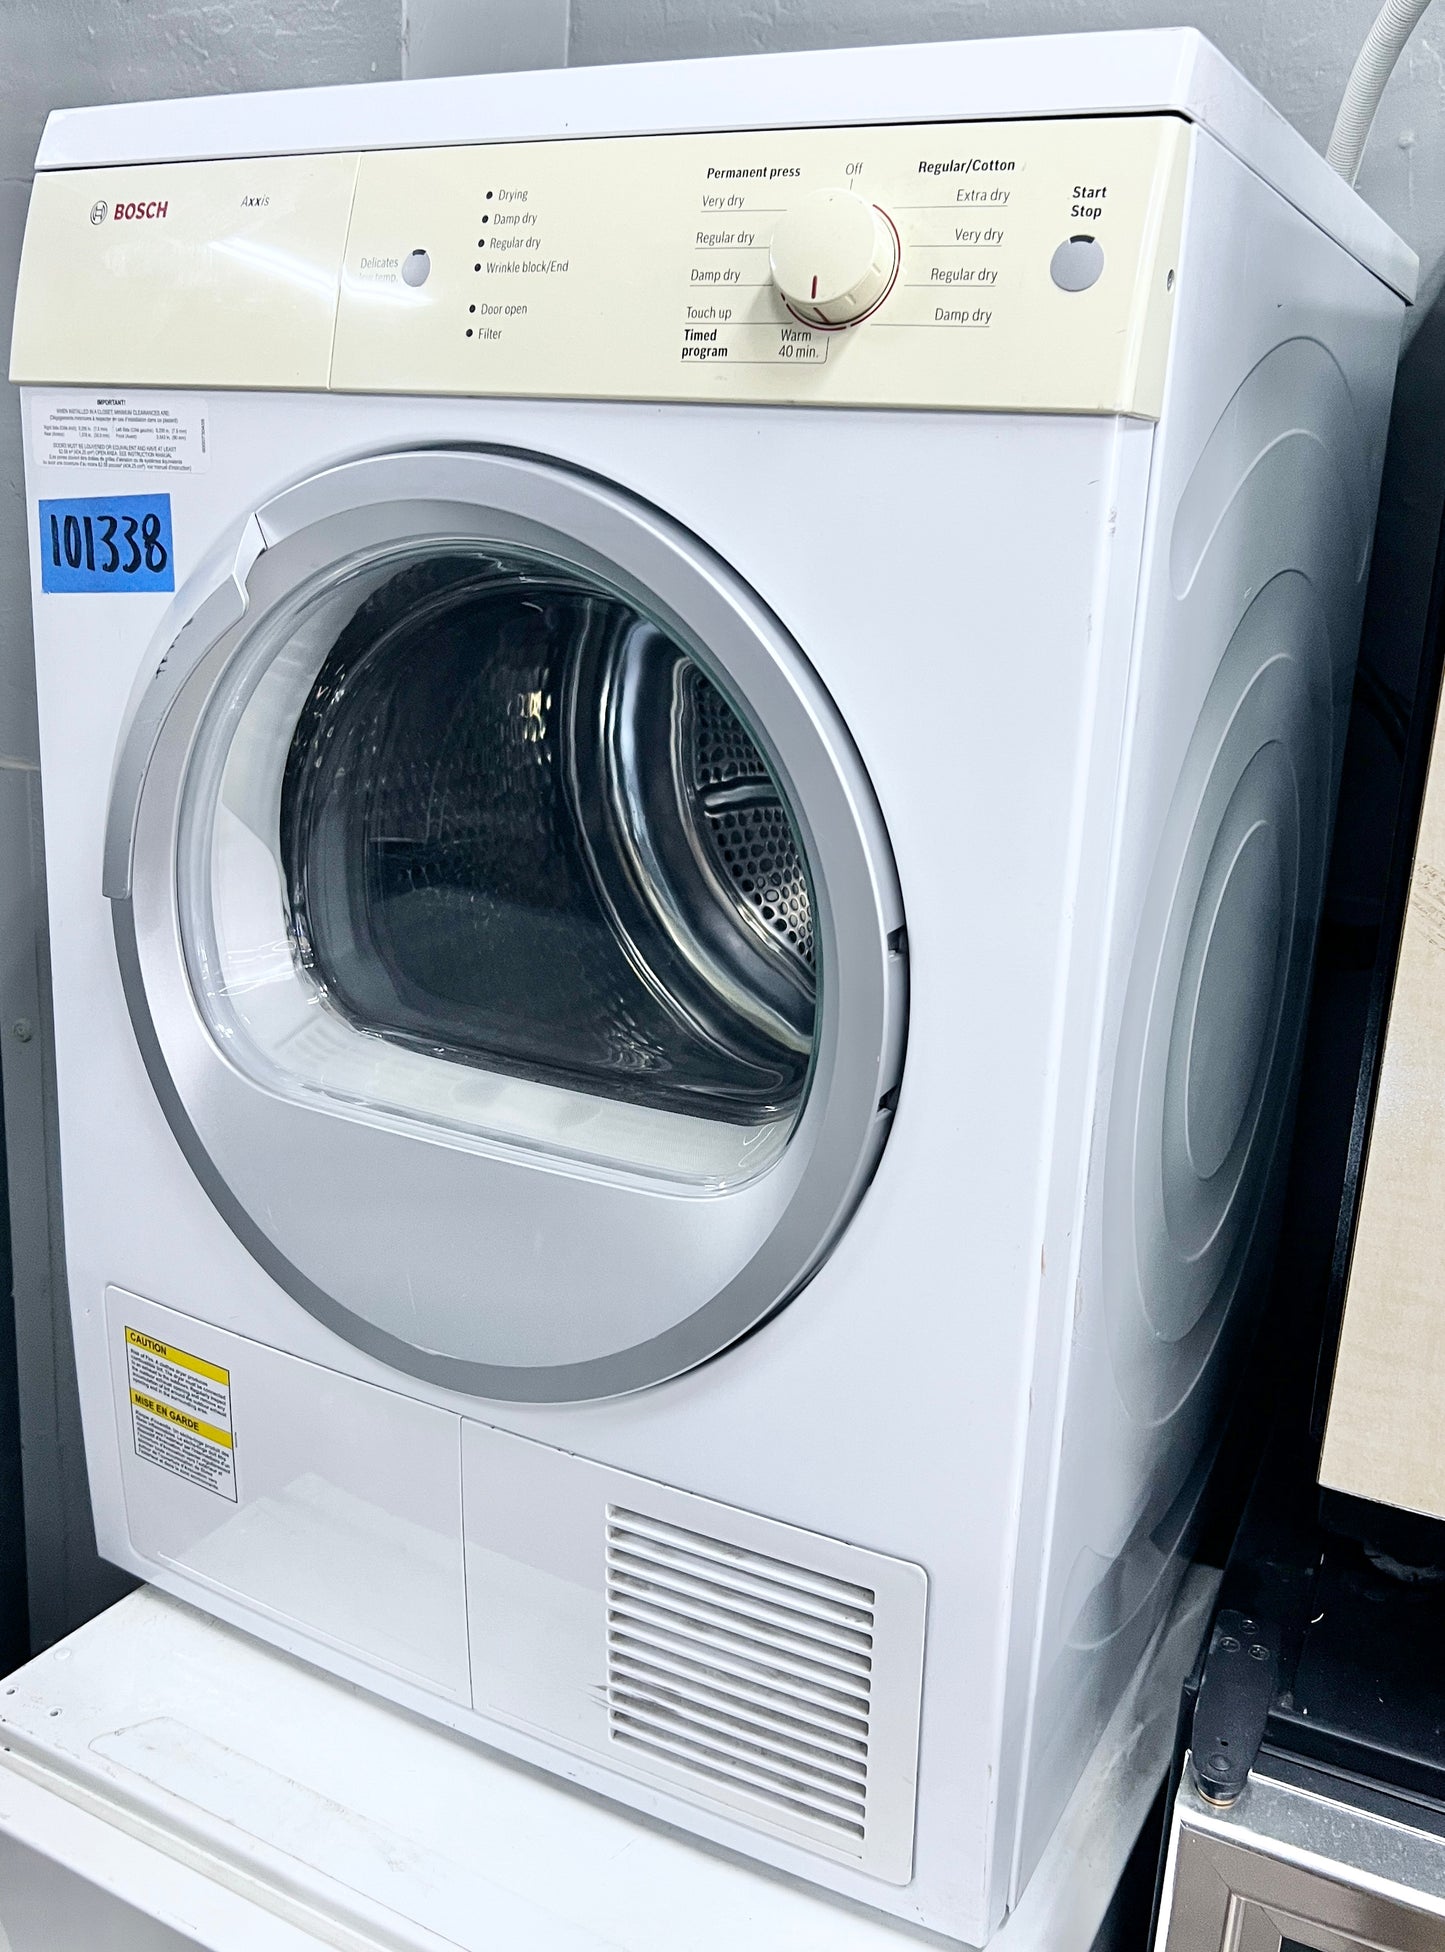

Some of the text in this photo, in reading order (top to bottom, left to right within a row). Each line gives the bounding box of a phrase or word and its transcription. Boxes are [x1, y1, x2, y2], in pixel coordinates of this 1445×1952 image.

[707, 167, 800, 180] Permanent press
[846, 162, 864, 175] Off
[918, 159, 1015, 175] Regular/Cotton
[498, 189, 528, 202] Drying
[956, 188, 1010, 203] Extra dry
[1072, 186, 1107, 198] Start
[241, 194, 270, 207] Axxis
[702, 195, 744, 209] Very dry
[114, 201, 168, 220] BOSCH
[1071, 205, 1102, 220] Stop
[494, 213, 537, 226] Damp dry
[696, 231, 755, 246] Regular dry
[955, 228, 1004, 243] Very dry
[490, 237, 541, 251] Regular dry
[360, 257, 399, 269] Delicates
[487, 260, 569, 274] Wrinkle block/End
[691, 269, 741, 283] Damp dry
[931, 267, 998, 284] Regular dry
[481, 304, 528, 316] Door open
[687, 306, 732, 320] Touch up
[935, 308, 992, 324] Damp dry
[478, 328, 501, 340] Filter
[684, 329, 717, 341] Timed
[781, 330, 811, 342] Warm
[682, 346, 728, 359] program
[779, 345, 818, 358] 40 min.
[51, 513, 168, 574] 101338
[130, 1332, 167, 1356] CAUTION
[135, 1394, 154, 1410] MISE
[156, 1402, 168, 1415] EN
[169, 1408, 200, 1431] GARDE
